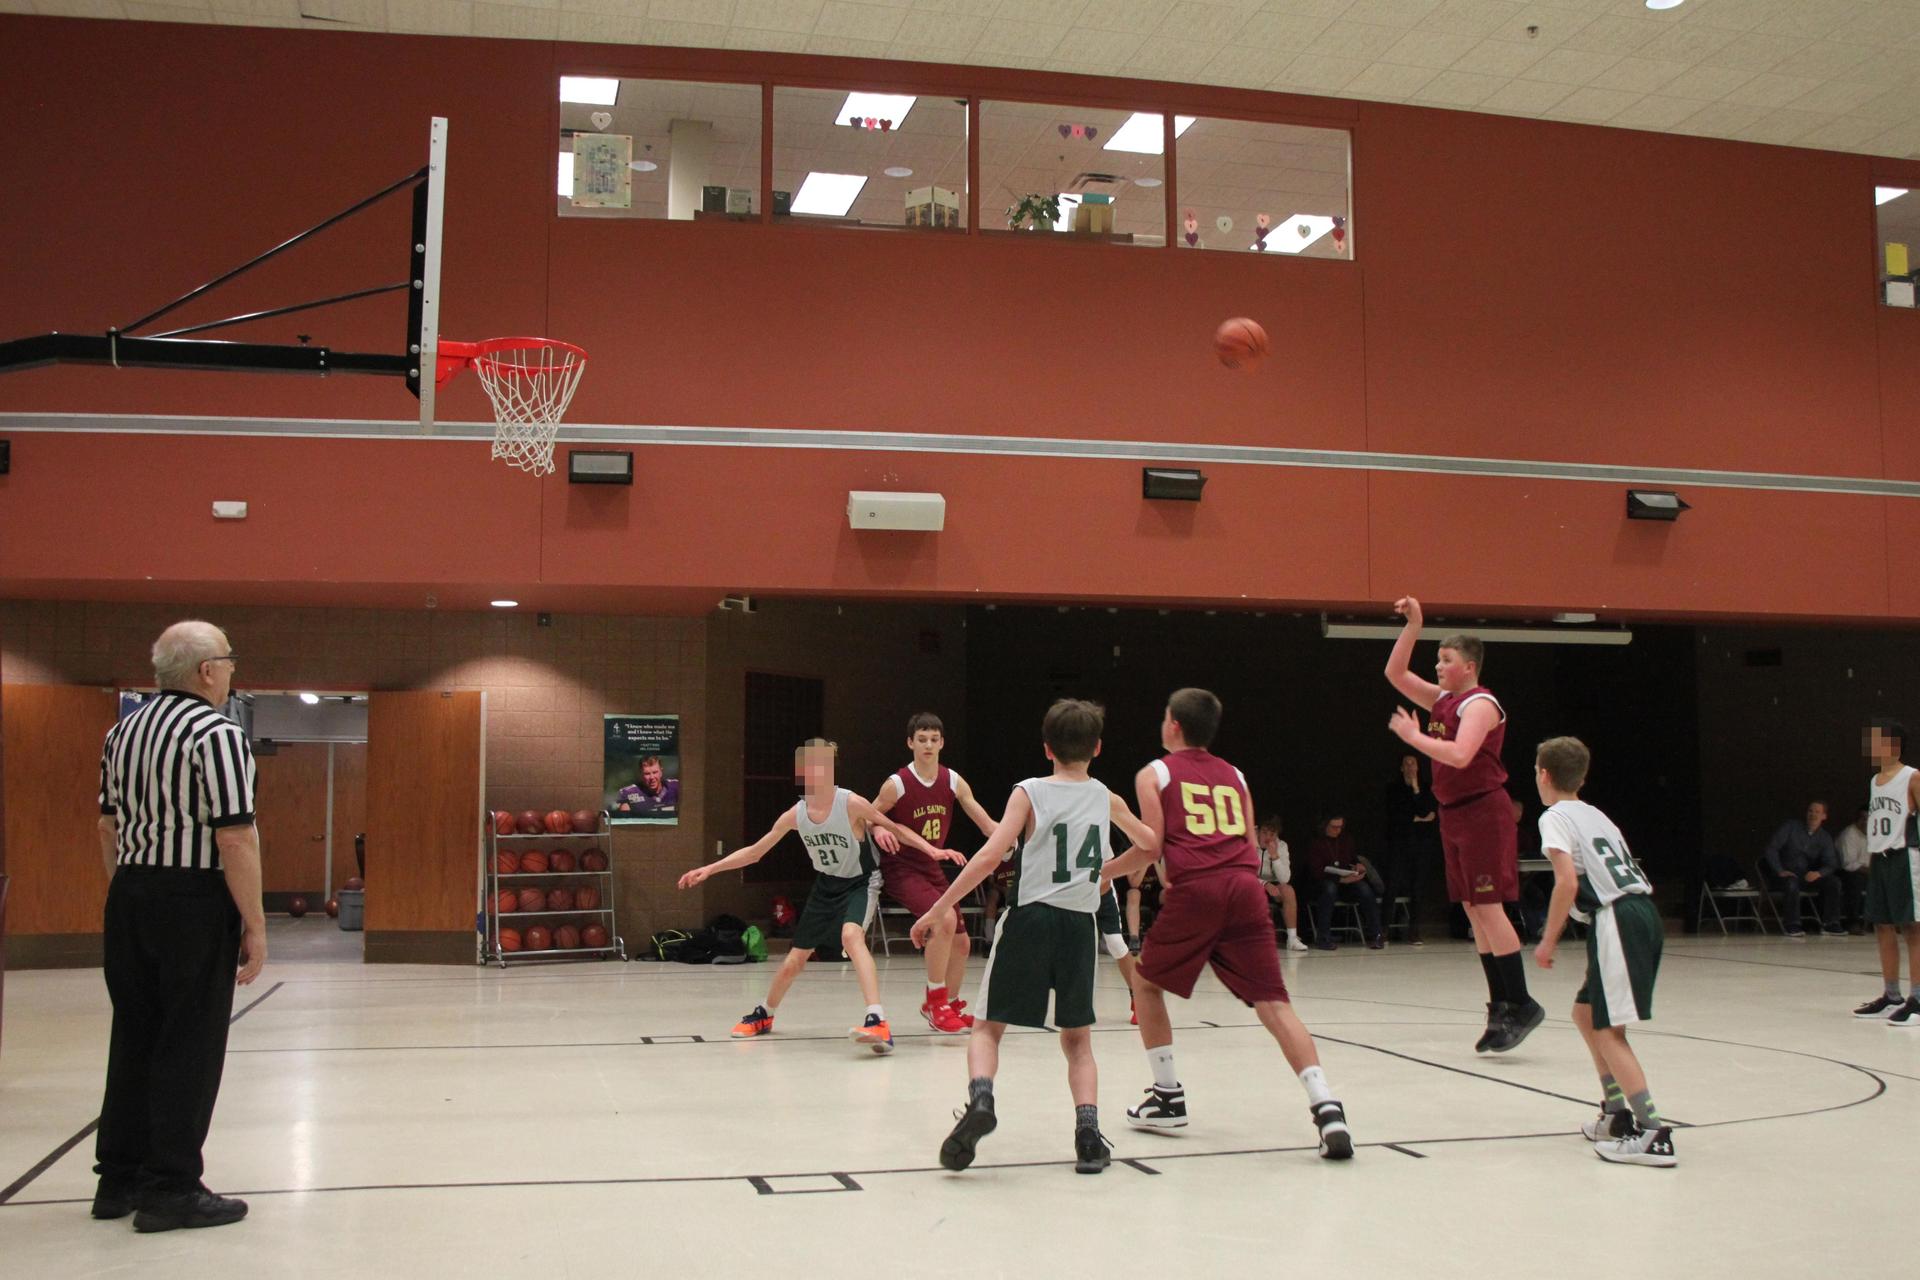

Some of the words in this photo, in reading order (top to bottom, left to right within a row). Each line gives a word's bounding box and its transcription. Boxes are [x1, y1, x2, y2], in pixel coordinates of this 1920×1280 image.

[913, 806, 926, 819] ALL
[926, 804, 947, 816] SAINTS
[1180, 782, 1246, 836] 50
[921, 818, 941, 840] 42
[803, 832, 849, 849] SAINTS
[818, 849, 839, 866] 21
[1052, 823, 1103, 884] 14
